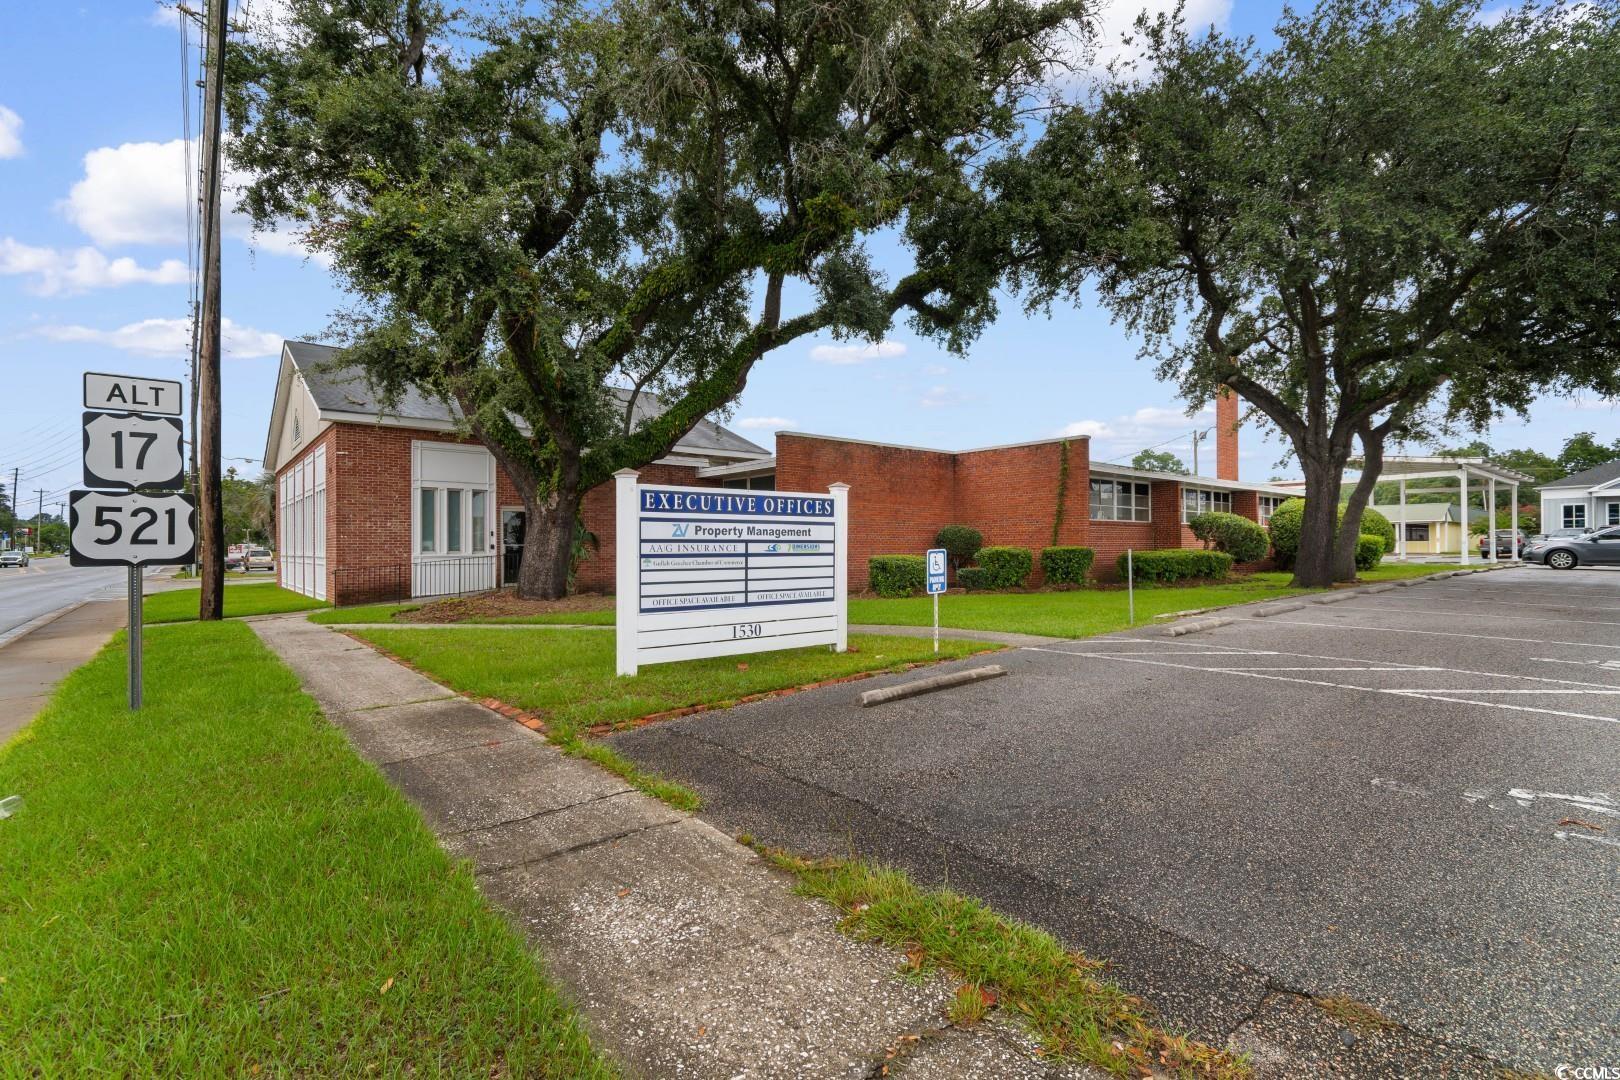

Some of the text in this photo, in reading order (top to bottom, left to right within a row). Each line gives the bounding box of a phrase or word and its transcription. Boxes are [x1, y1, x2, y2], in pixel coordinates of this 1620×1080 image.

[106, 383, 165, 406] ALT
[111, 430, 158, 470] 17
[644, 492, 832, 515] EXECUTIVE OFFICES
[93, 506, 176, 546] 521
[694, 525, 812, 539] Property Management
[649, 543, 738, 553] AAG INSURANCE
[652, 598, 679, 606] OFFICE
[679, 597, 700, 605] SPACE
[732, 623, 762, 639] 1530
